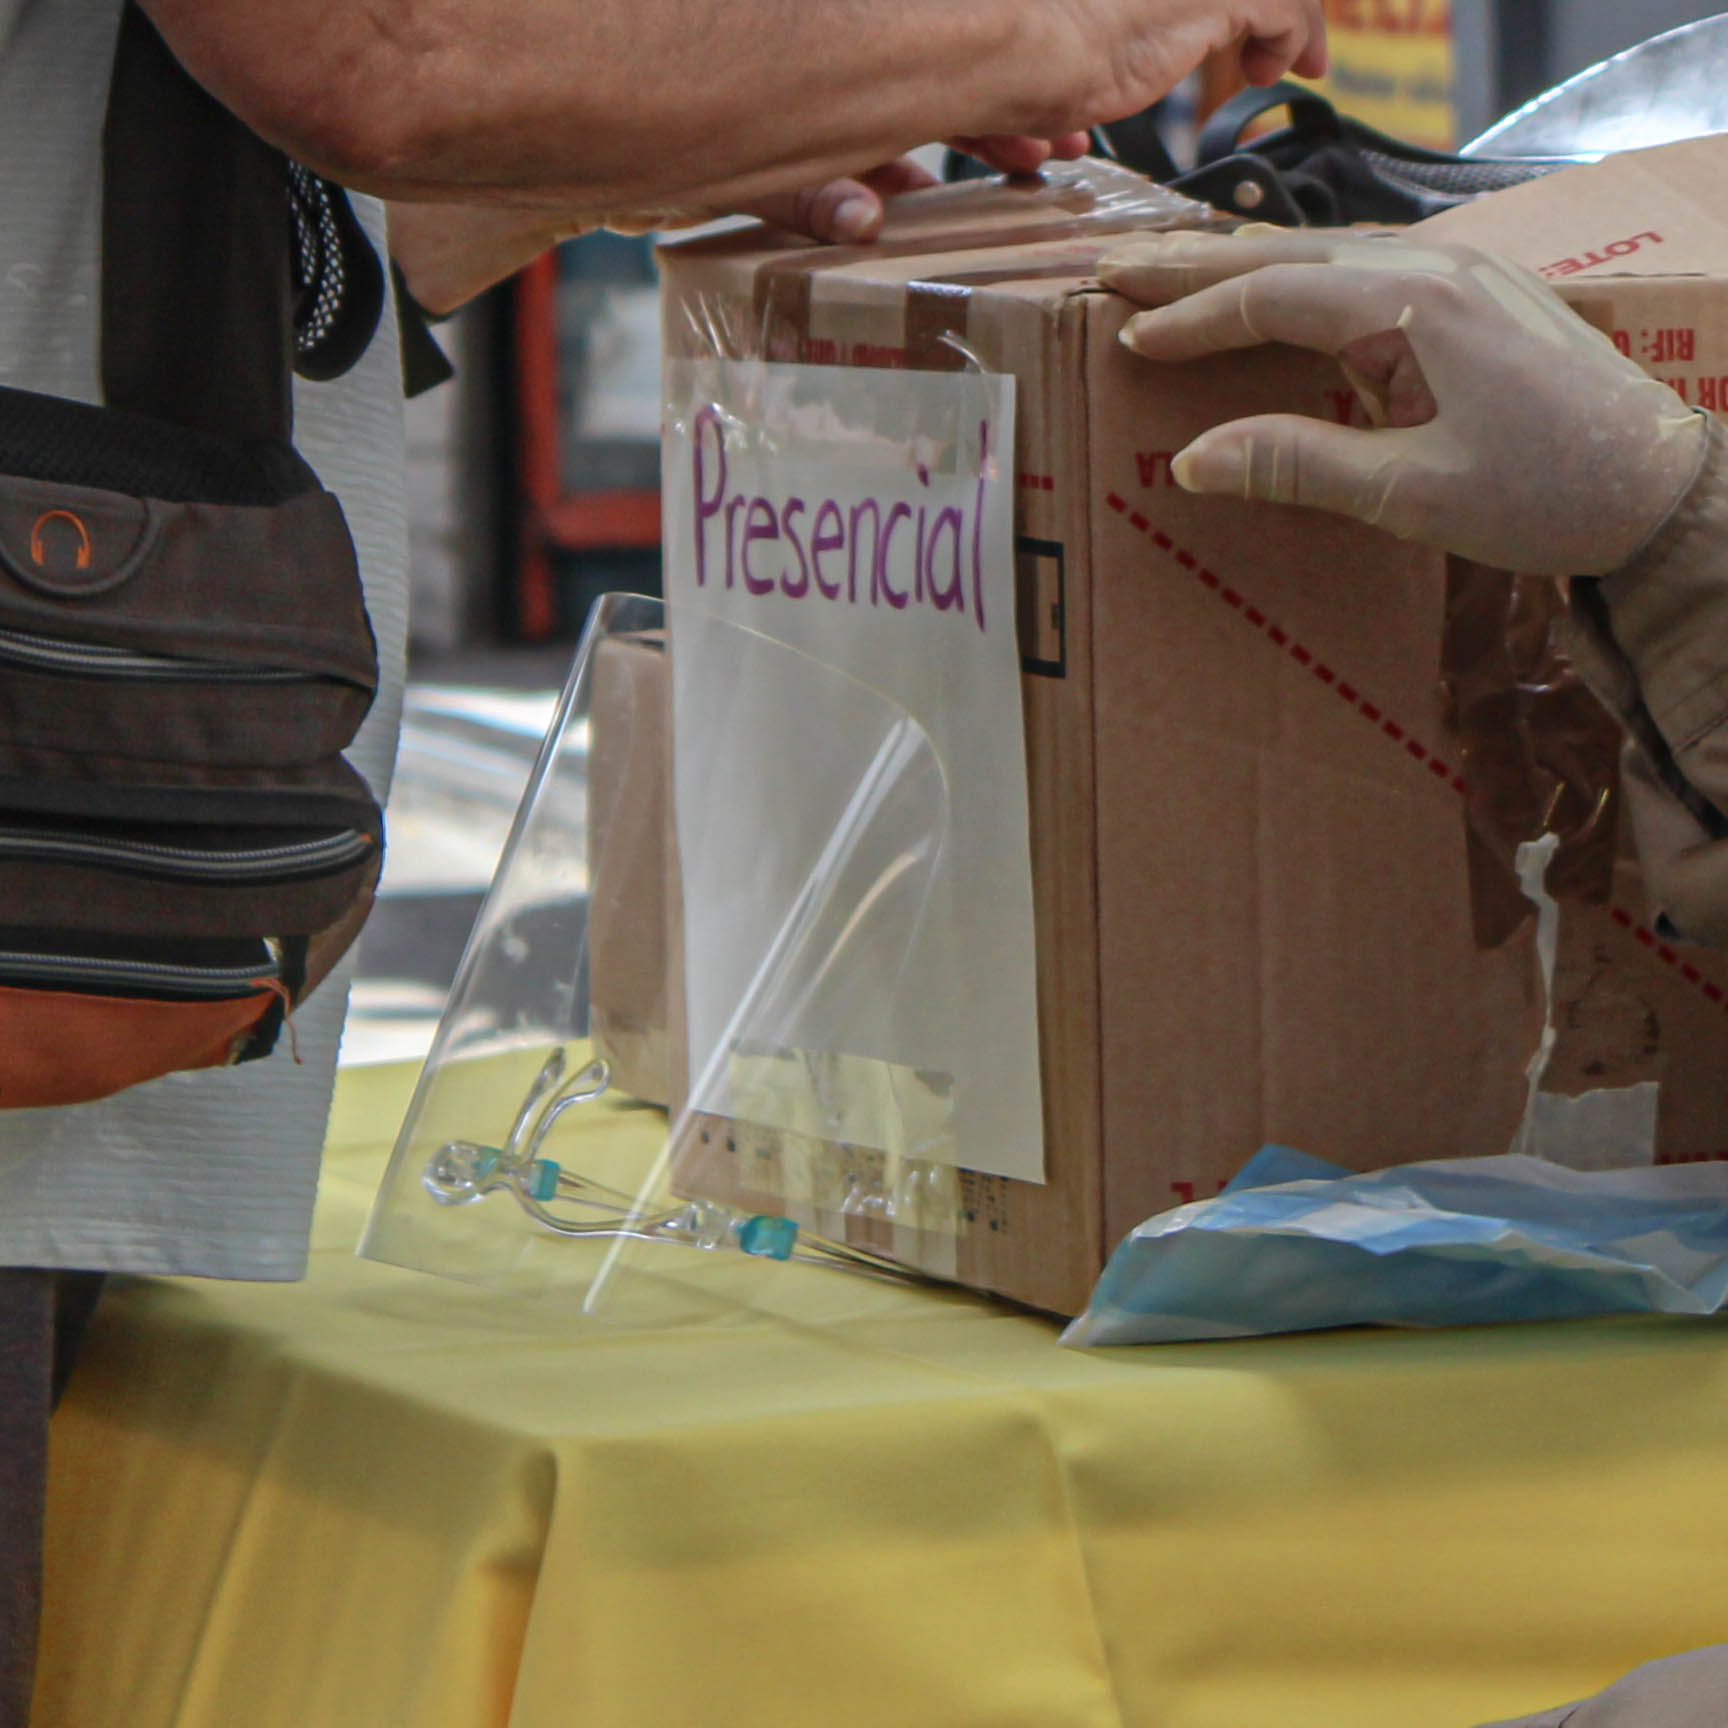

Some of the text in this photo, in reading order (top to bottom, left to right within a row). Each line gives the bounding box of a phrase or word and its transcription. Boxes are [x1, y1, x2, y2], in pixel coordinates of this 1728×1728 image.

[1537, 231, 1664, 277] LOTE:
[1641, 329, 1694, 363] RIF:
[693, 403, 988, 634] Presencial
